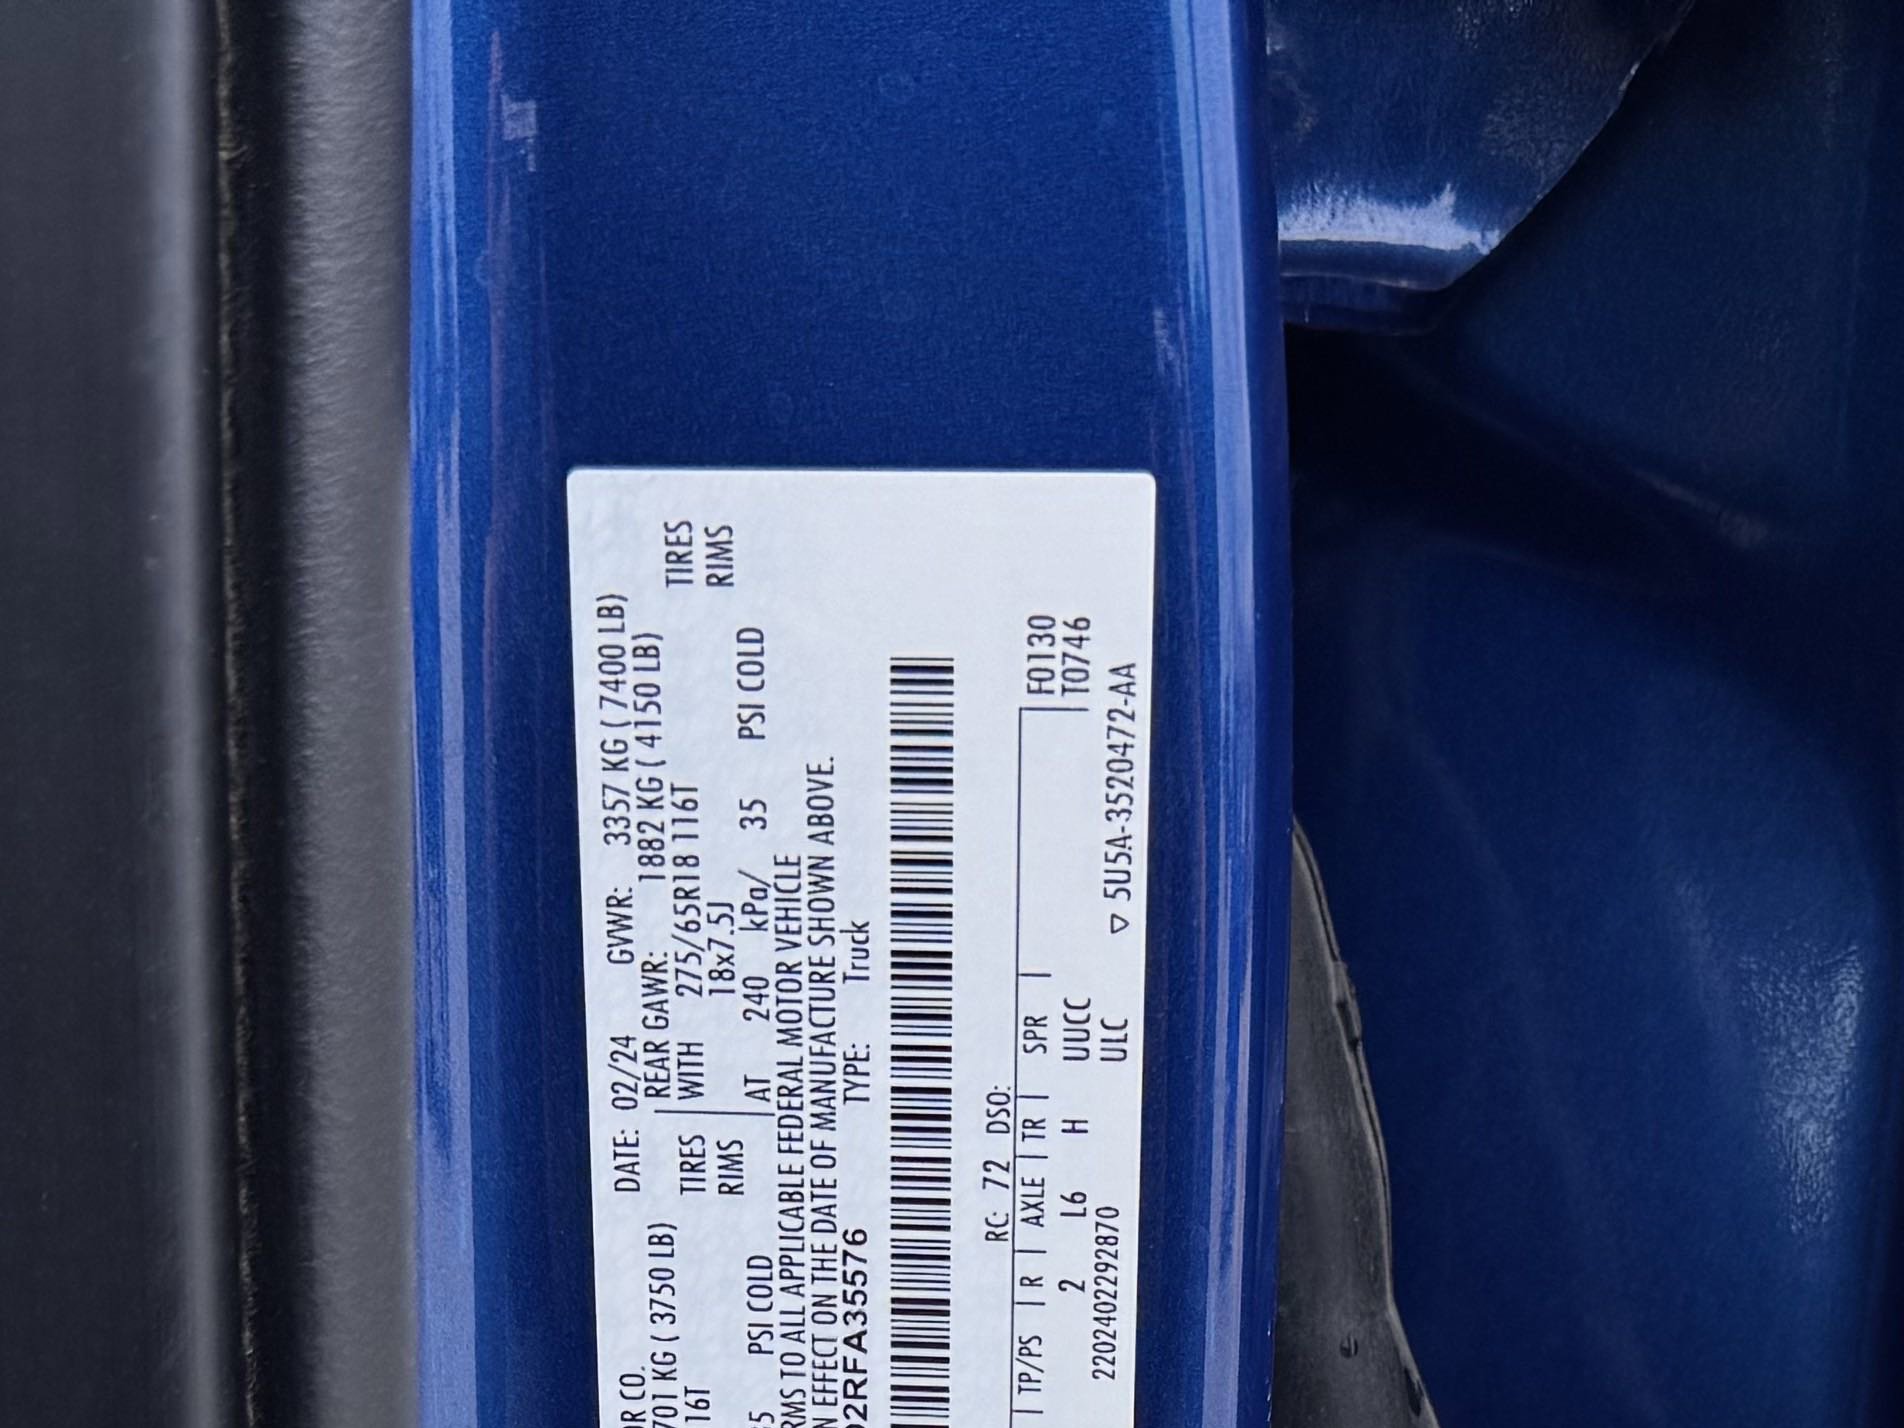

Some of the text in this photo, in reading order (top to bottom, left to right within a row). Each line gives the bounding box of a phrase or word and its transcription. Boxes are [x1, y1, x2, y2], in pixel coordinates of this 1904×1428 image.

[1027, 615, 1056, 696] F0130
[1062, 617, 1091, 697] T0746
[596, 593, 635, 965] GVWR: 3357 KG 7400 LB)
[704, 525, 736, 996] 18x7.5J RIMS
[1103, 663, 1137, 901] 5U5A-3520472-AA
[663, 520, 705, 1100] WITH 275/65R18 116T TIRES
[806, 756, 834, 845] ABOVE.
[631, 632, 670, 1098] REAR GAWR: 1882 KG 4150 LB)
[736, 627, 771, 1102] AT 240 kPa/ 35 PSI COLD
[774, 855, 802, 952] VEHICLE
[807, 856, 835, 946] SHOWN
[775, 961, 803, 1047] MOTOR
[839, 920, 870, 1105] TYPE: Truck
[1023, 1016, 1047, 1054] SPR
[1063, 997, 1091, 1061] UUCC
[808, 955, 836, 1131] MANUFACTURE
[1100, 1018, 1128, 1061] ULC
[608, 1034, 641, 1192] DATE: 02/24
[776, 1056, 804, 1154] FEDERAL
[982, 1086, 1011, 1190] 72 DSO:
[1021, 1118, 1046, 1141] TR
[678, 1134, 706, 1195] TIRES
[716, 1139, 745, 1195] RIMS
[809, 1139, 837, 1169] OF
[778, 1164, 805, 1297] APPLICABLE
[810, 1178, 837, 1233] DATE
[1020, 1177, 1044, 1227] AXLE
[647, 1222, 678, 1258] LB)
[810, 1243, 837, 1285] THE
[649, 1267, 676, 1325] 3750
[746, 1255, 773, 1312] COLD
[810, 1294, 837, 1325] ON
[1092, 1207, 1119, 1380] 2202402292870
[747, 1322, 774, 1355] PSI
[779, 1305, 806, 1344] ALL
[619, 1366, 646, 1400] CO.
[650, 1352, 677, 1381] KG
[780, 1352, 806, 1379] TO
[811, 1333, 838, 1406] EFFECT
[1015, 1335, 1044, 1394] TP/PS
